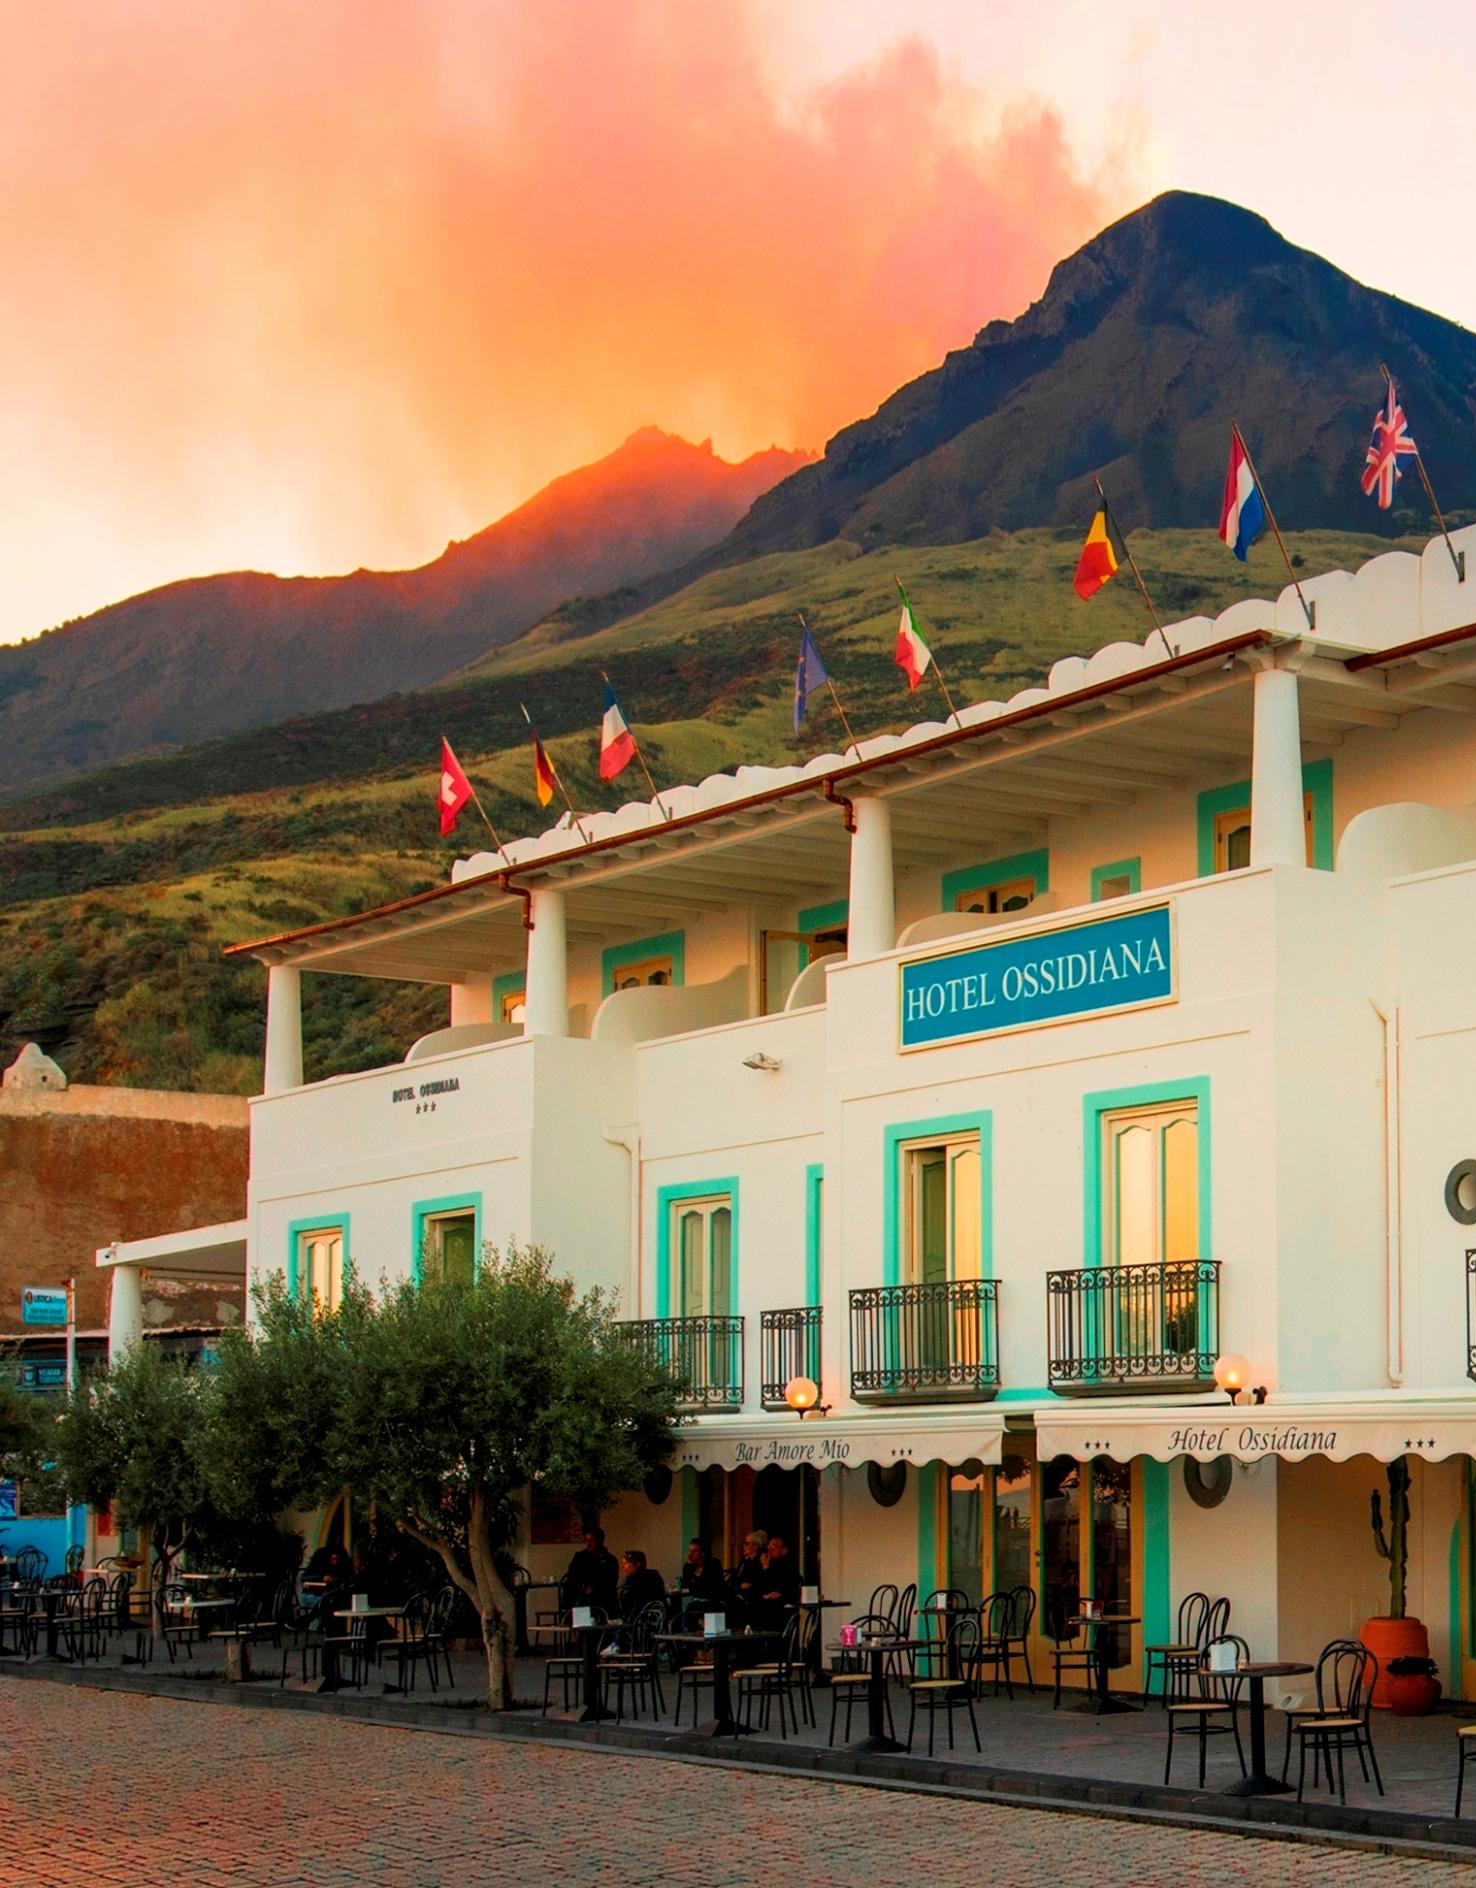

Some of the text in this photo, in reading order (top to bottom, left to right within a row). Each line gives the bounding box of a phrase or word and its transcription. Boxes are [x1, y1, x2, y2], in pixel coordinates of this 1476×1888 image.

[907, 937, 1167, 1022] HOTEL OSSIDIANA
[392, 1087, 416, 1103] HOTEL
[735, 1438, 850, 1462] Bar Amore Mio
[1168, 1426, 1337, 1451] Hotel Ossidiana
